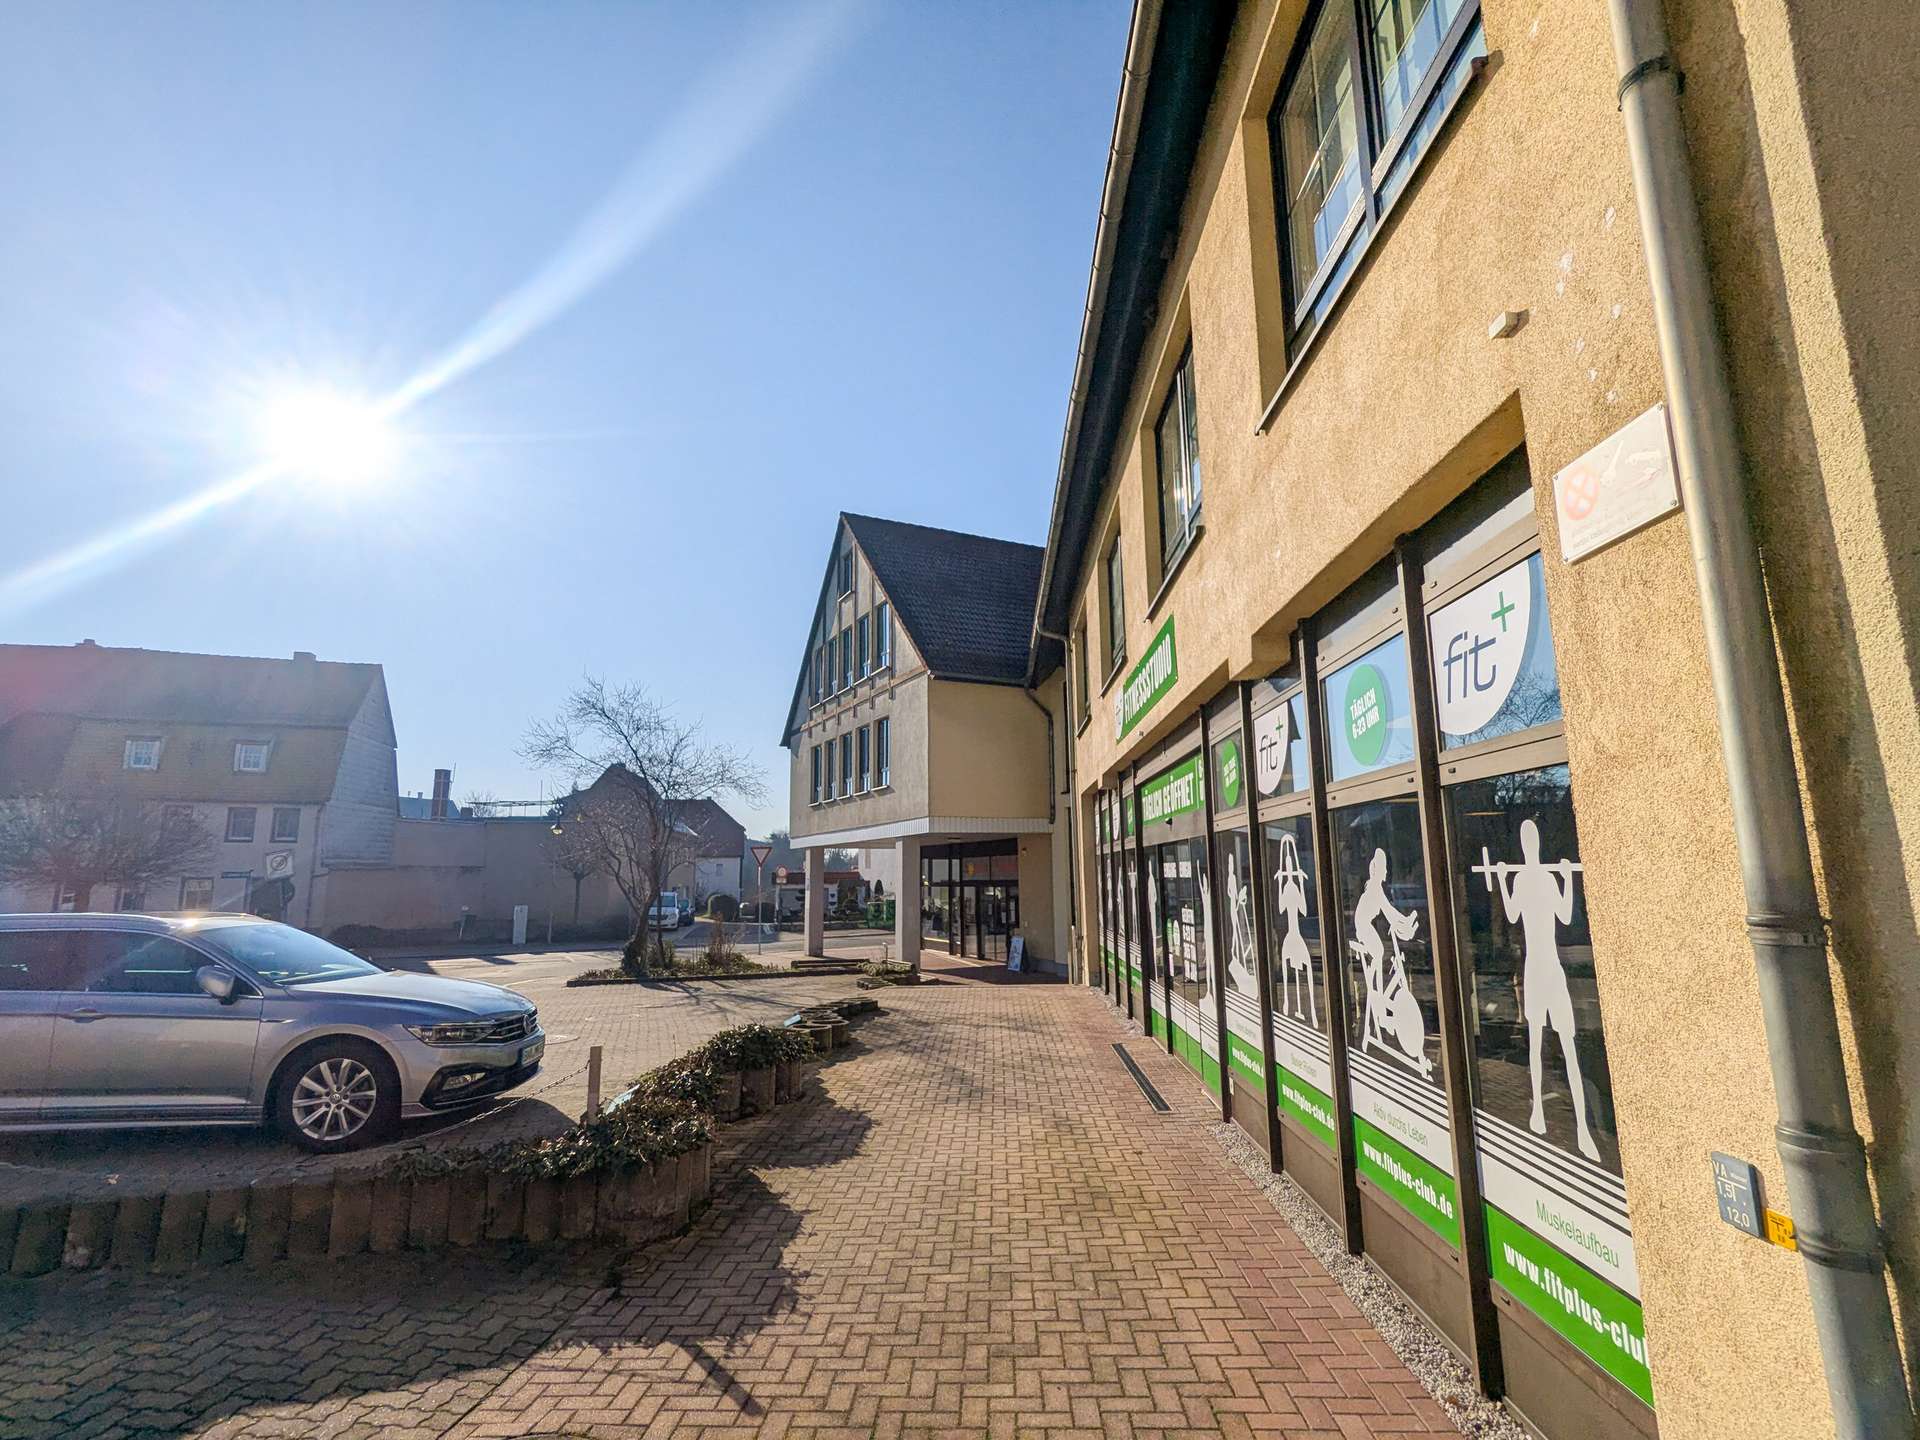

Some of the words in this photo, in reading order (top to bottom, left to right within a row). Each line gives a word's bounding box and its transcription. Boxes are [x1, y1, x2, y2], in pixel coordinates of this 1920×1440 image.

[1124, 633, 1172, 724] FITNESSSTUDIO
[1350, 688, 1377, 720] TÄGLICH
[1352, 715, 1367, 739] 6-23
[1365, 705, 1380, 728] UHR
[1163, 772, 1194, 814] GEÖFFNET
[1362, 1141, 1454, 1219] www.fitplus-club.de
[1536, 1199, 1620, 1269] Muskelaufbau
